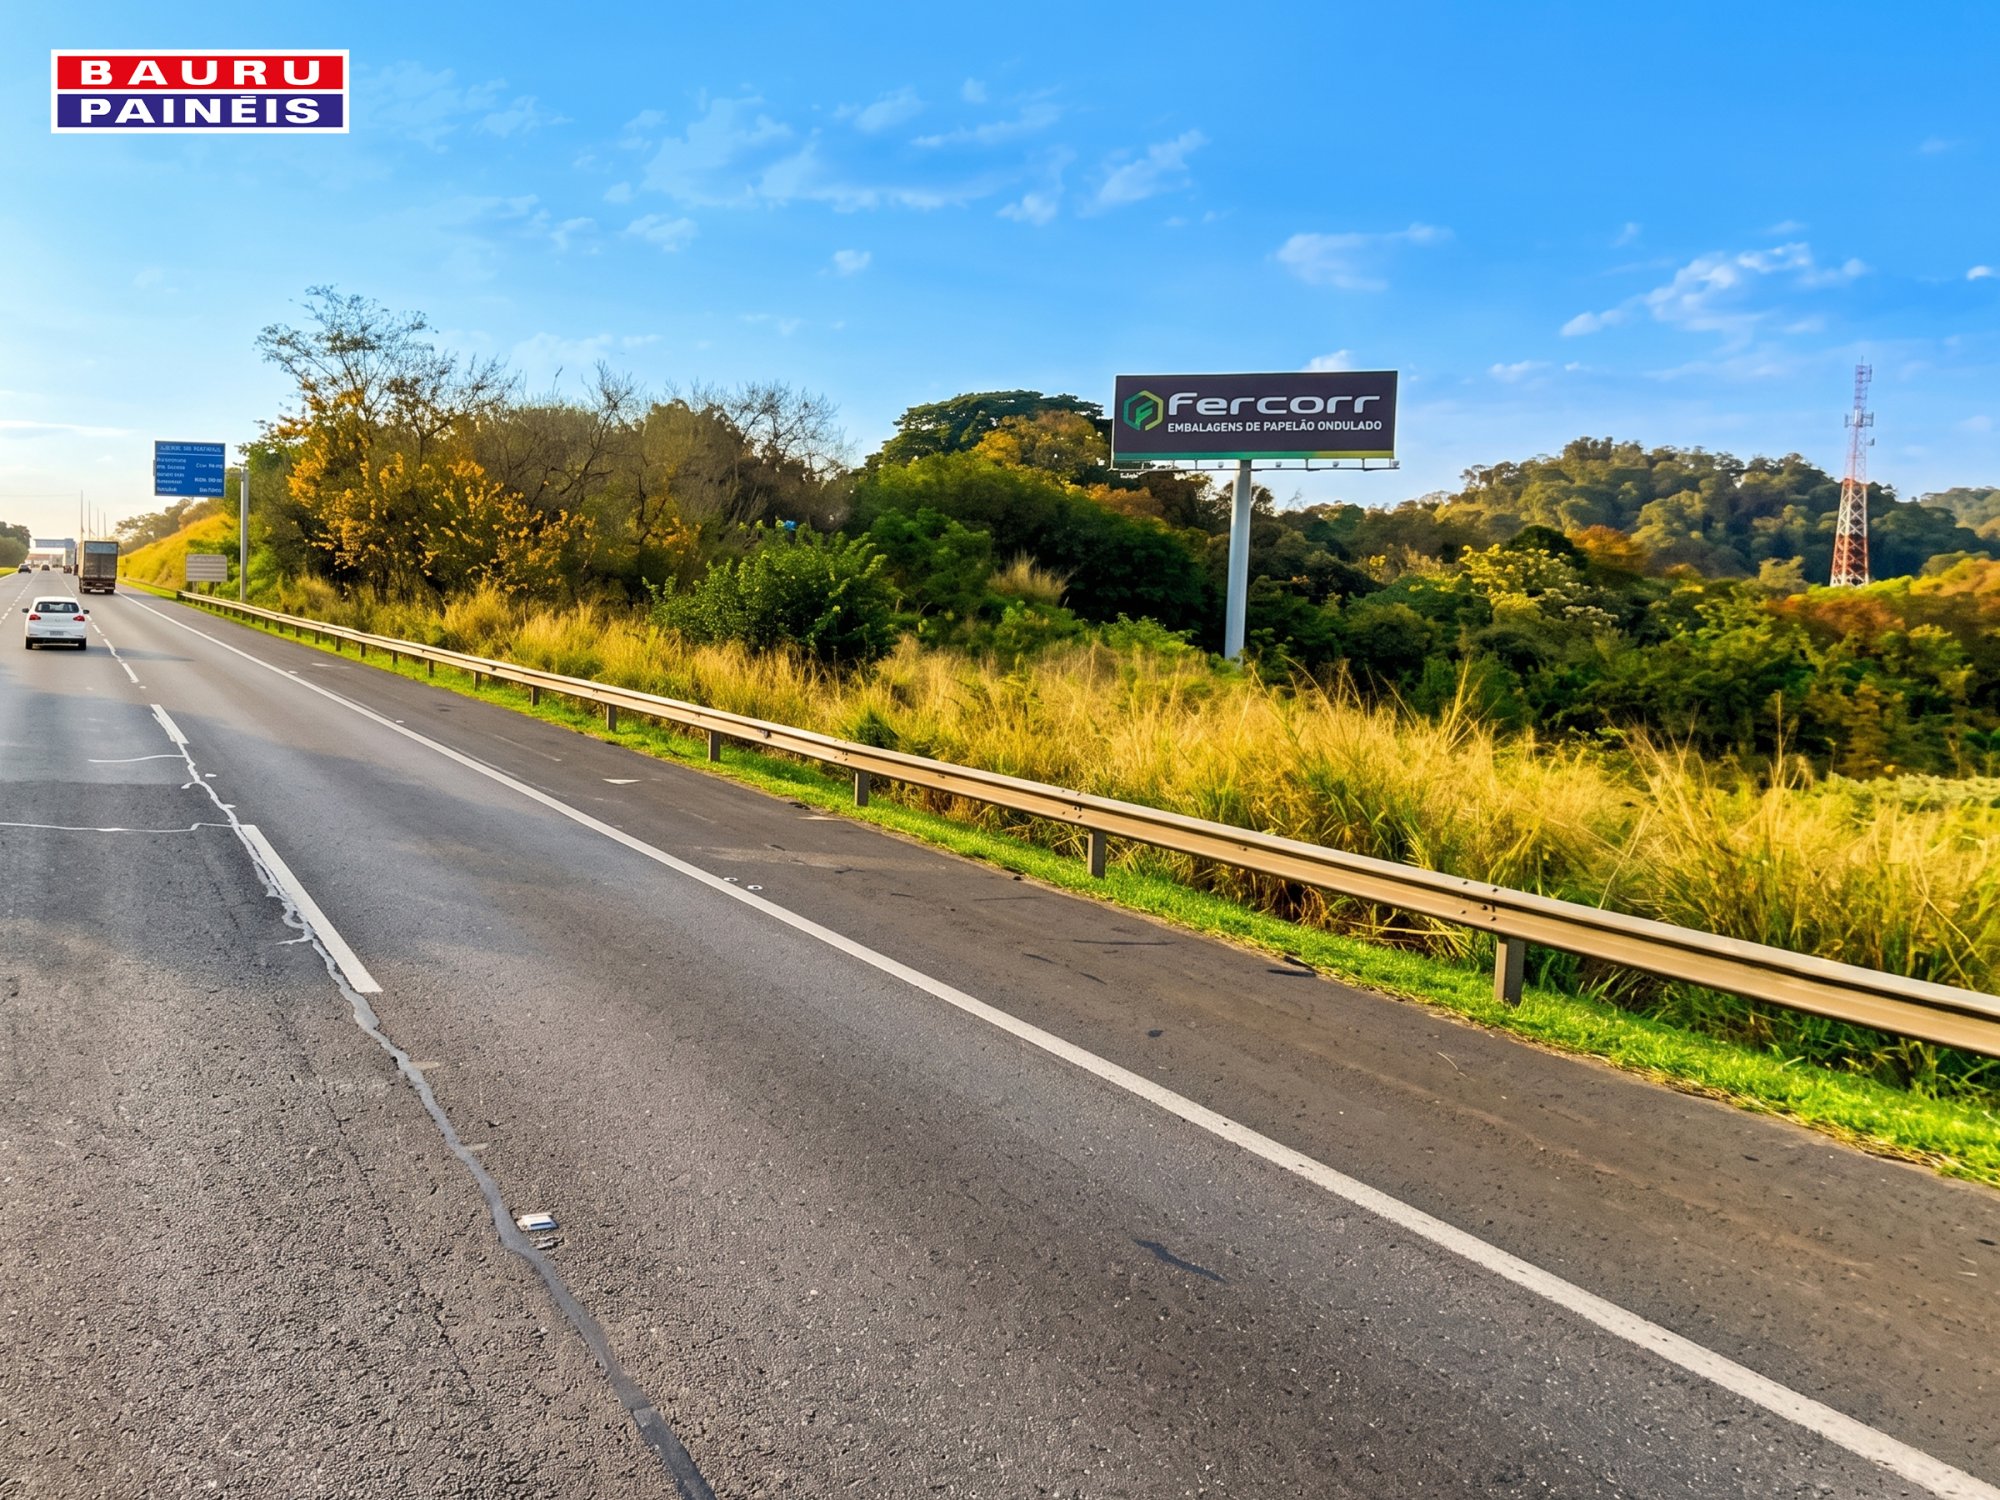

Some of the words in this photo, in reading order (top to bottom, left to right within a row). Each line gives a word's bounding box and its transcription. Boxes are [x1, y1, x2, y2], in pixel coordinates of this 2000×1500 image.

[1167, 422, 1243, 433] EMBALAGENS
[1246, 422, 1261, 432] DE
[1264, 418, 1315, 431] PAPELÃO
[1318, 420, 1382, 431] ONDULADO
